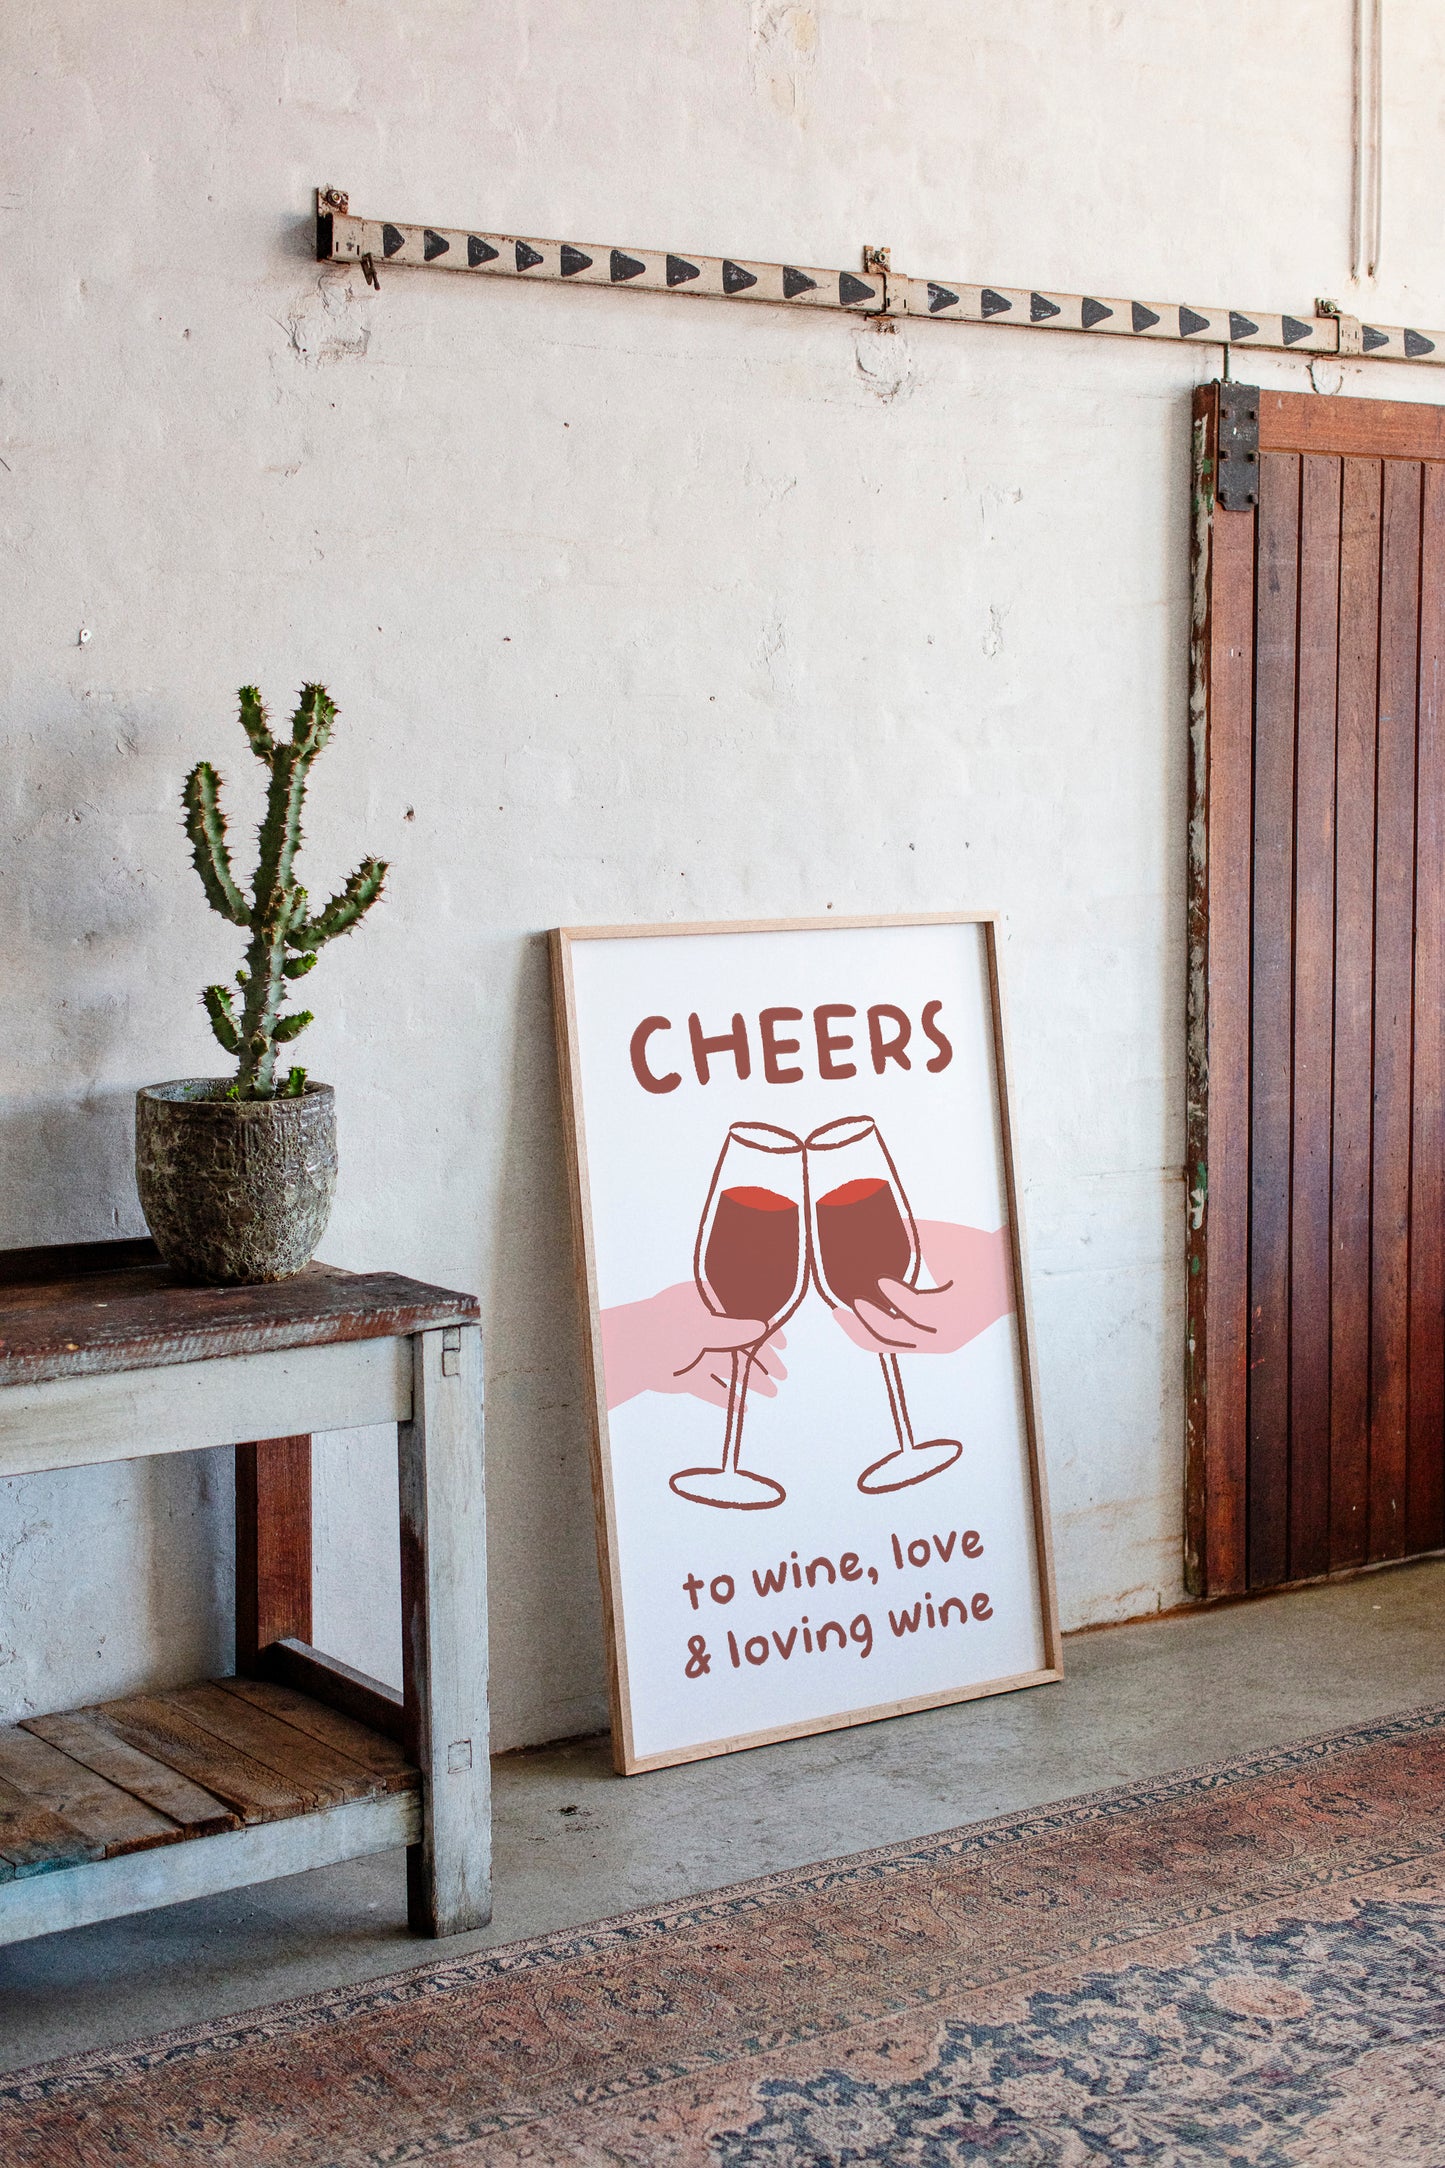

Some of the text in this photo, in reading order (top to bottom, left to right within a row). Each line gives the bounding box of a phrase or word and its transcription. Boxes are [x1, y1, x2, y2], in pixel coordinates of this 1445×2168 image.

[629, 999, 953, 1095] CHEERS
[683, 1529, 985, 1611] to wine, love
[684, 1591, 994, 1679] & loving wine
